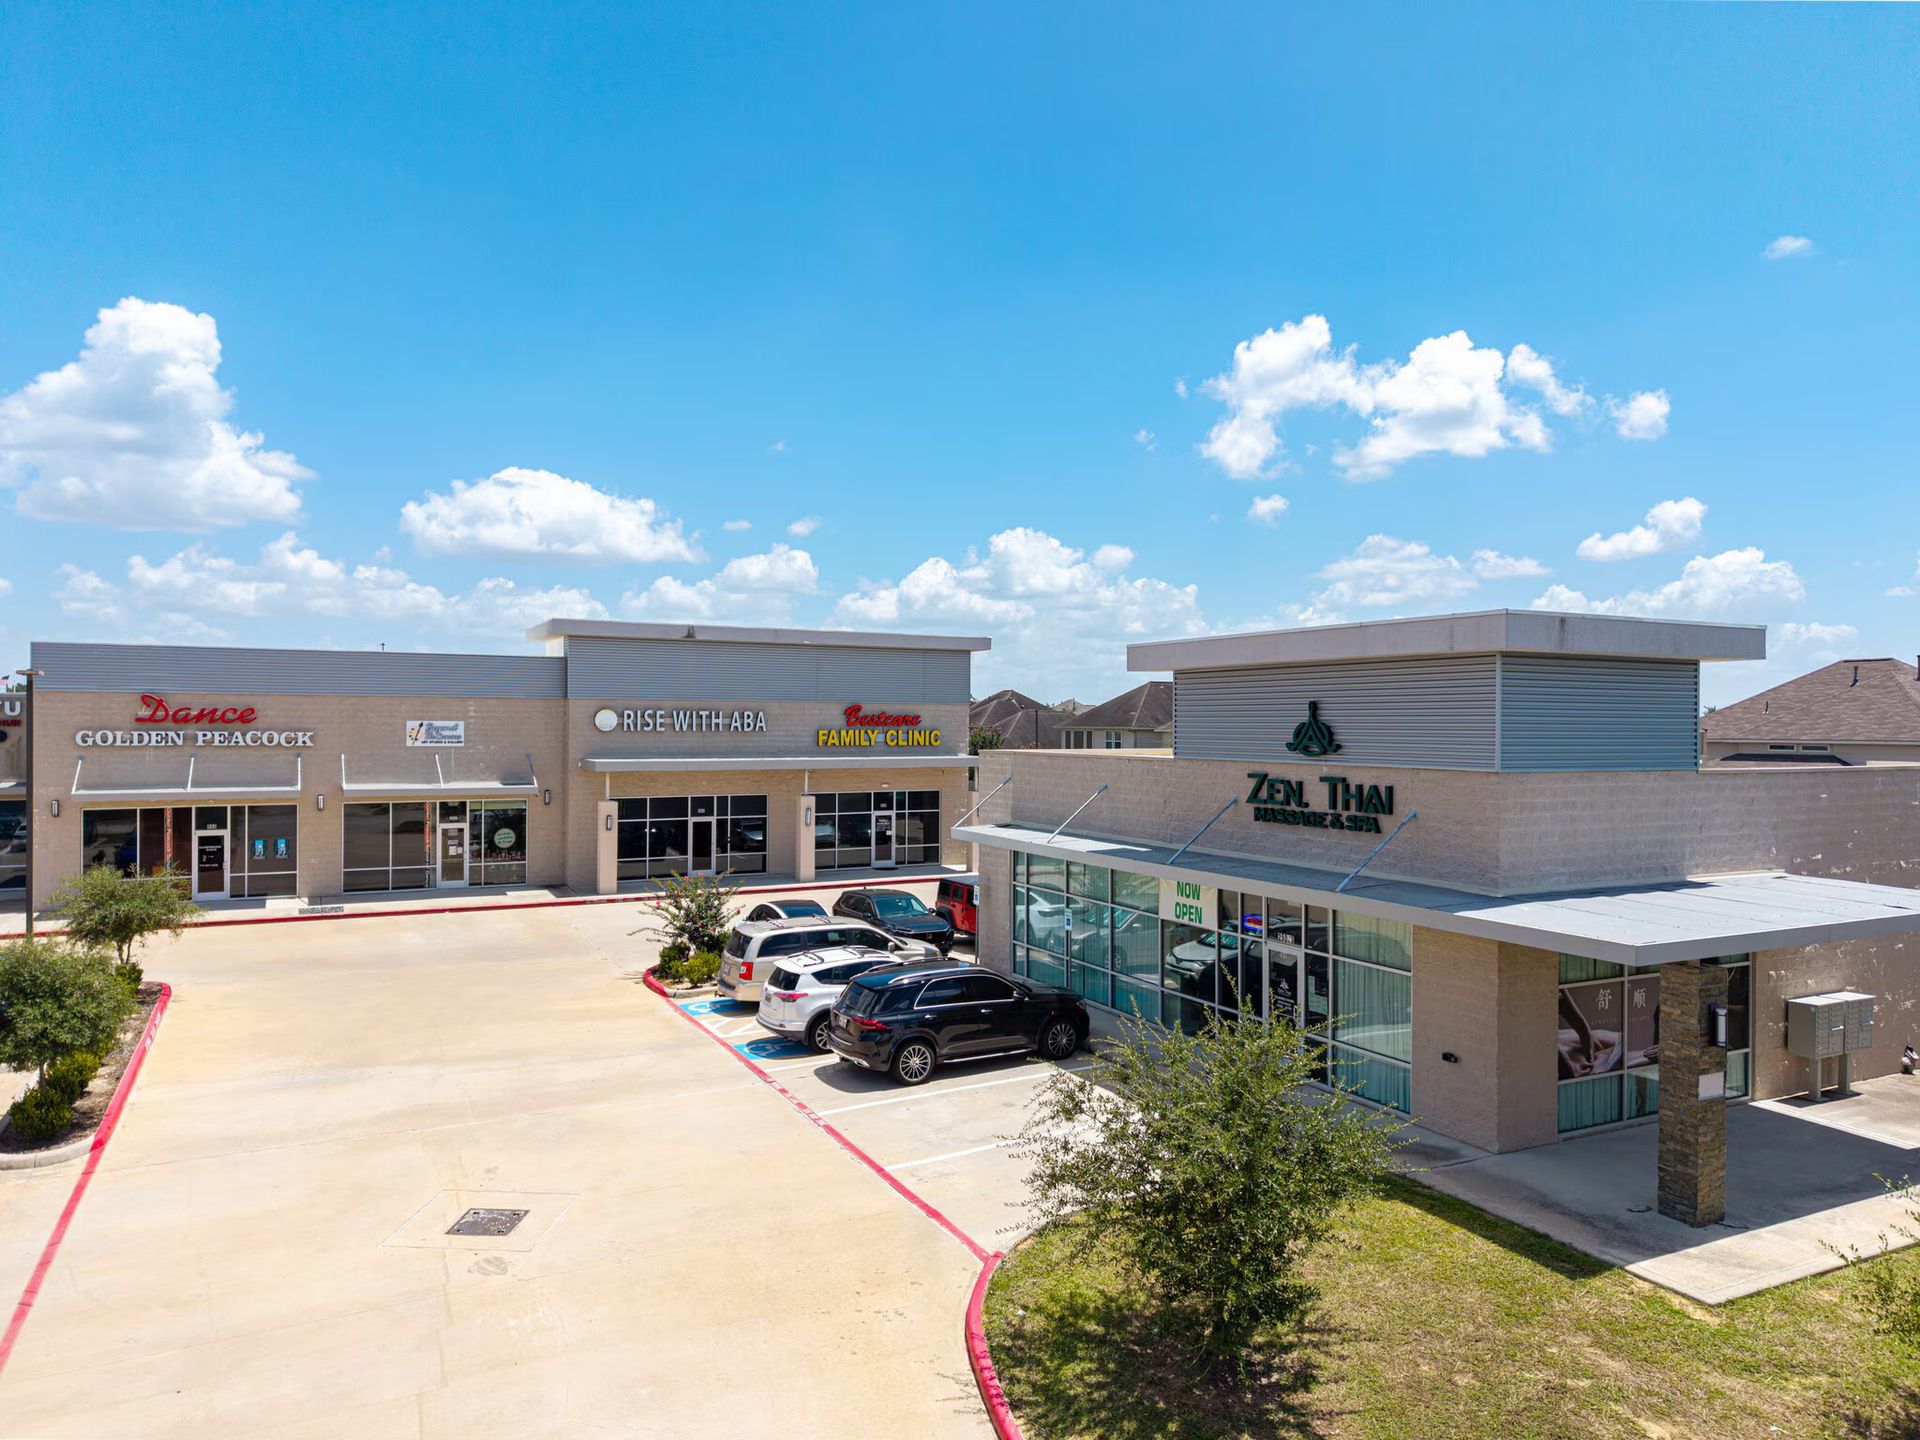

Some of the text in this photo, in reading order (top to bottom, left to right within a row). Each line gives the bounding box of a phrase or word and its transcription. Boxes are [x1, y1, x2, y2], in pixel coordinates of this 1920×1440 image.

[135, 694, 257, 724] Dance
[623, 710, 767, 732] RISE WITH ABA
[75, 730, 314, 747] GOLDEN PEACOCK
[817, 729, 941, 747] FAMILY CLINIC
[1253, 806, 1329, 829] MASSAGE
[1345, 814, 1382, 834] SPA
[1176, 880, 1201, 901] NOW
[1174, 901, 1203, 925] OPEN
